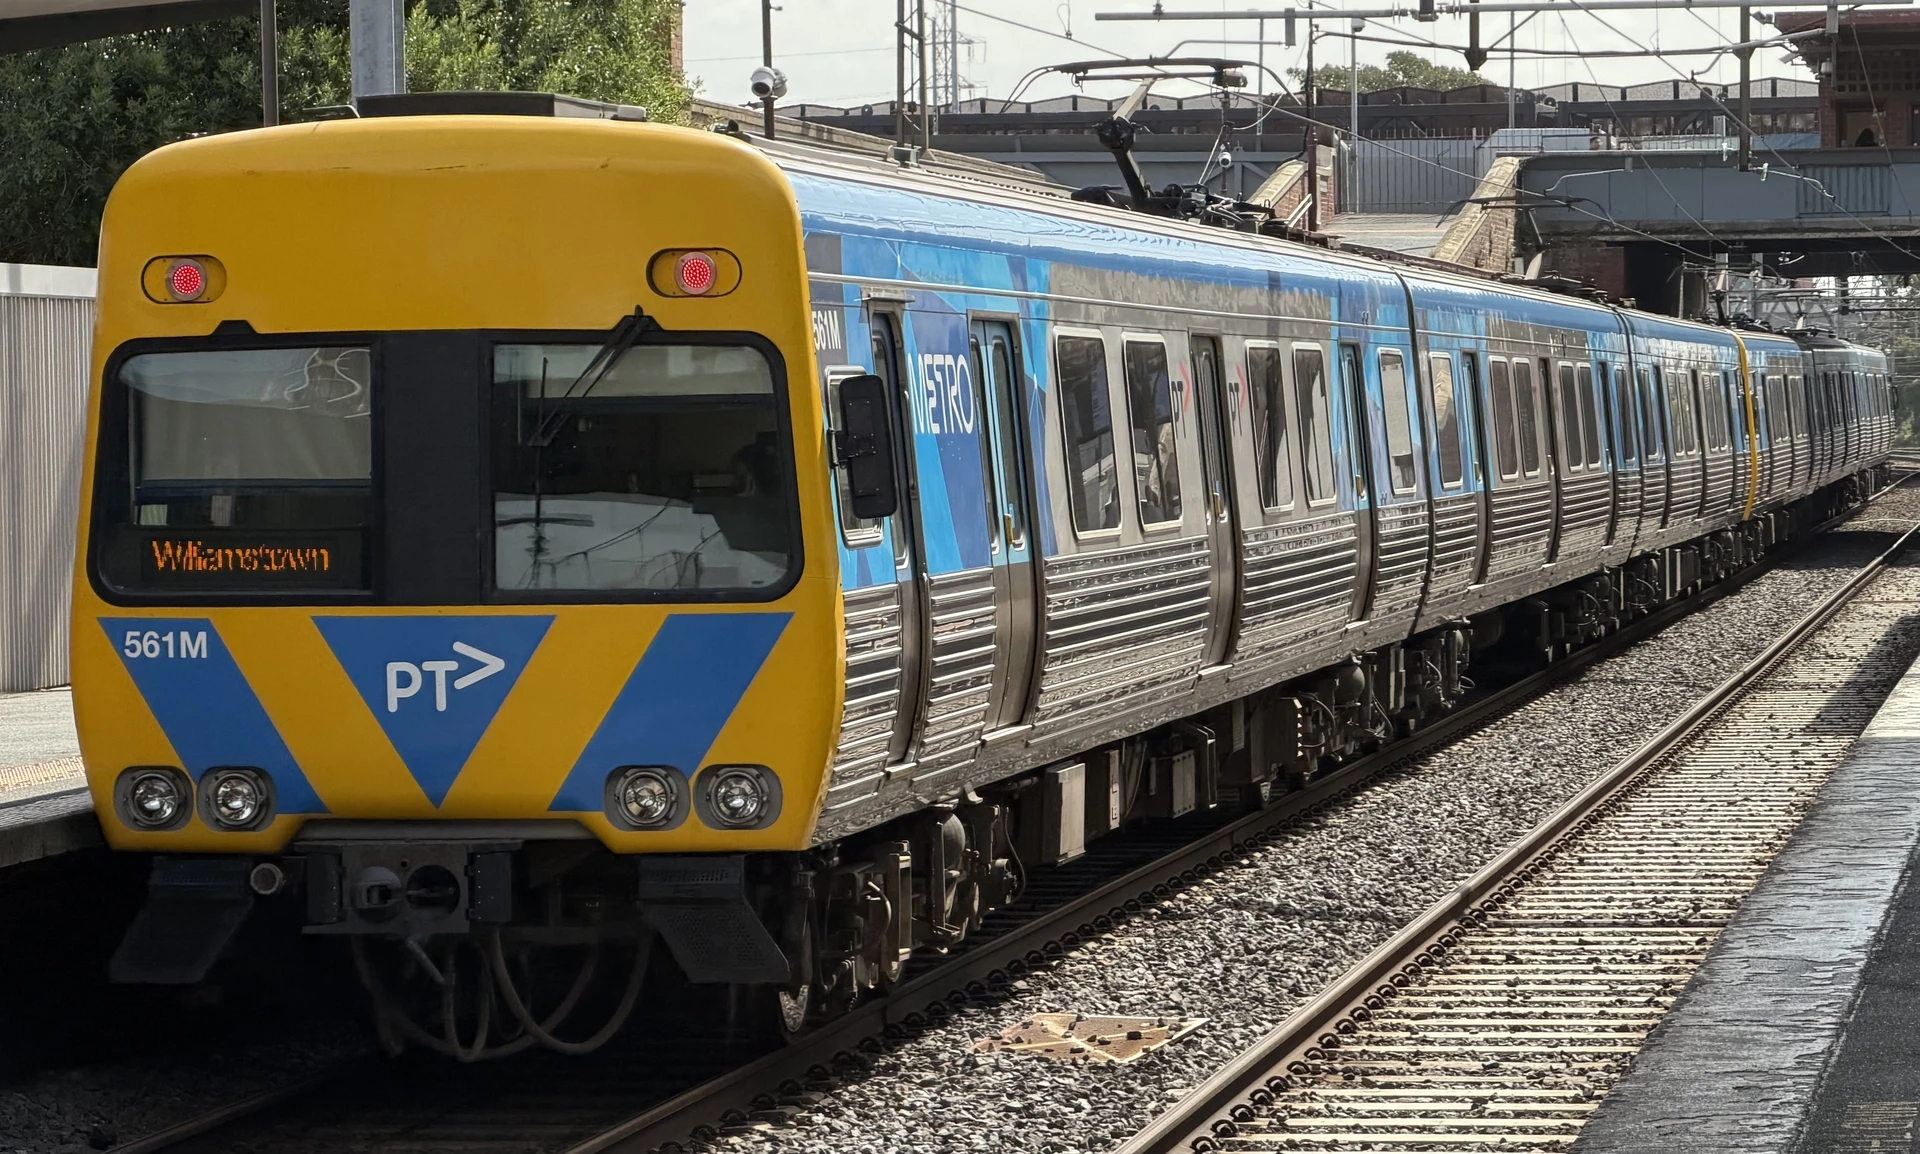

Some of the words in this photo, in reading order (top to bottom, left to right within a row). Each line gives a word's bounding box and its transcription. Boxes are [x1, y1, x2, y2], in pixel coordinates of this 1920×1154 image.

[811, 310, 842, 351] 561M
[907, 353, 974, 435] METRO
[123, 630, 208, 659] 561M
